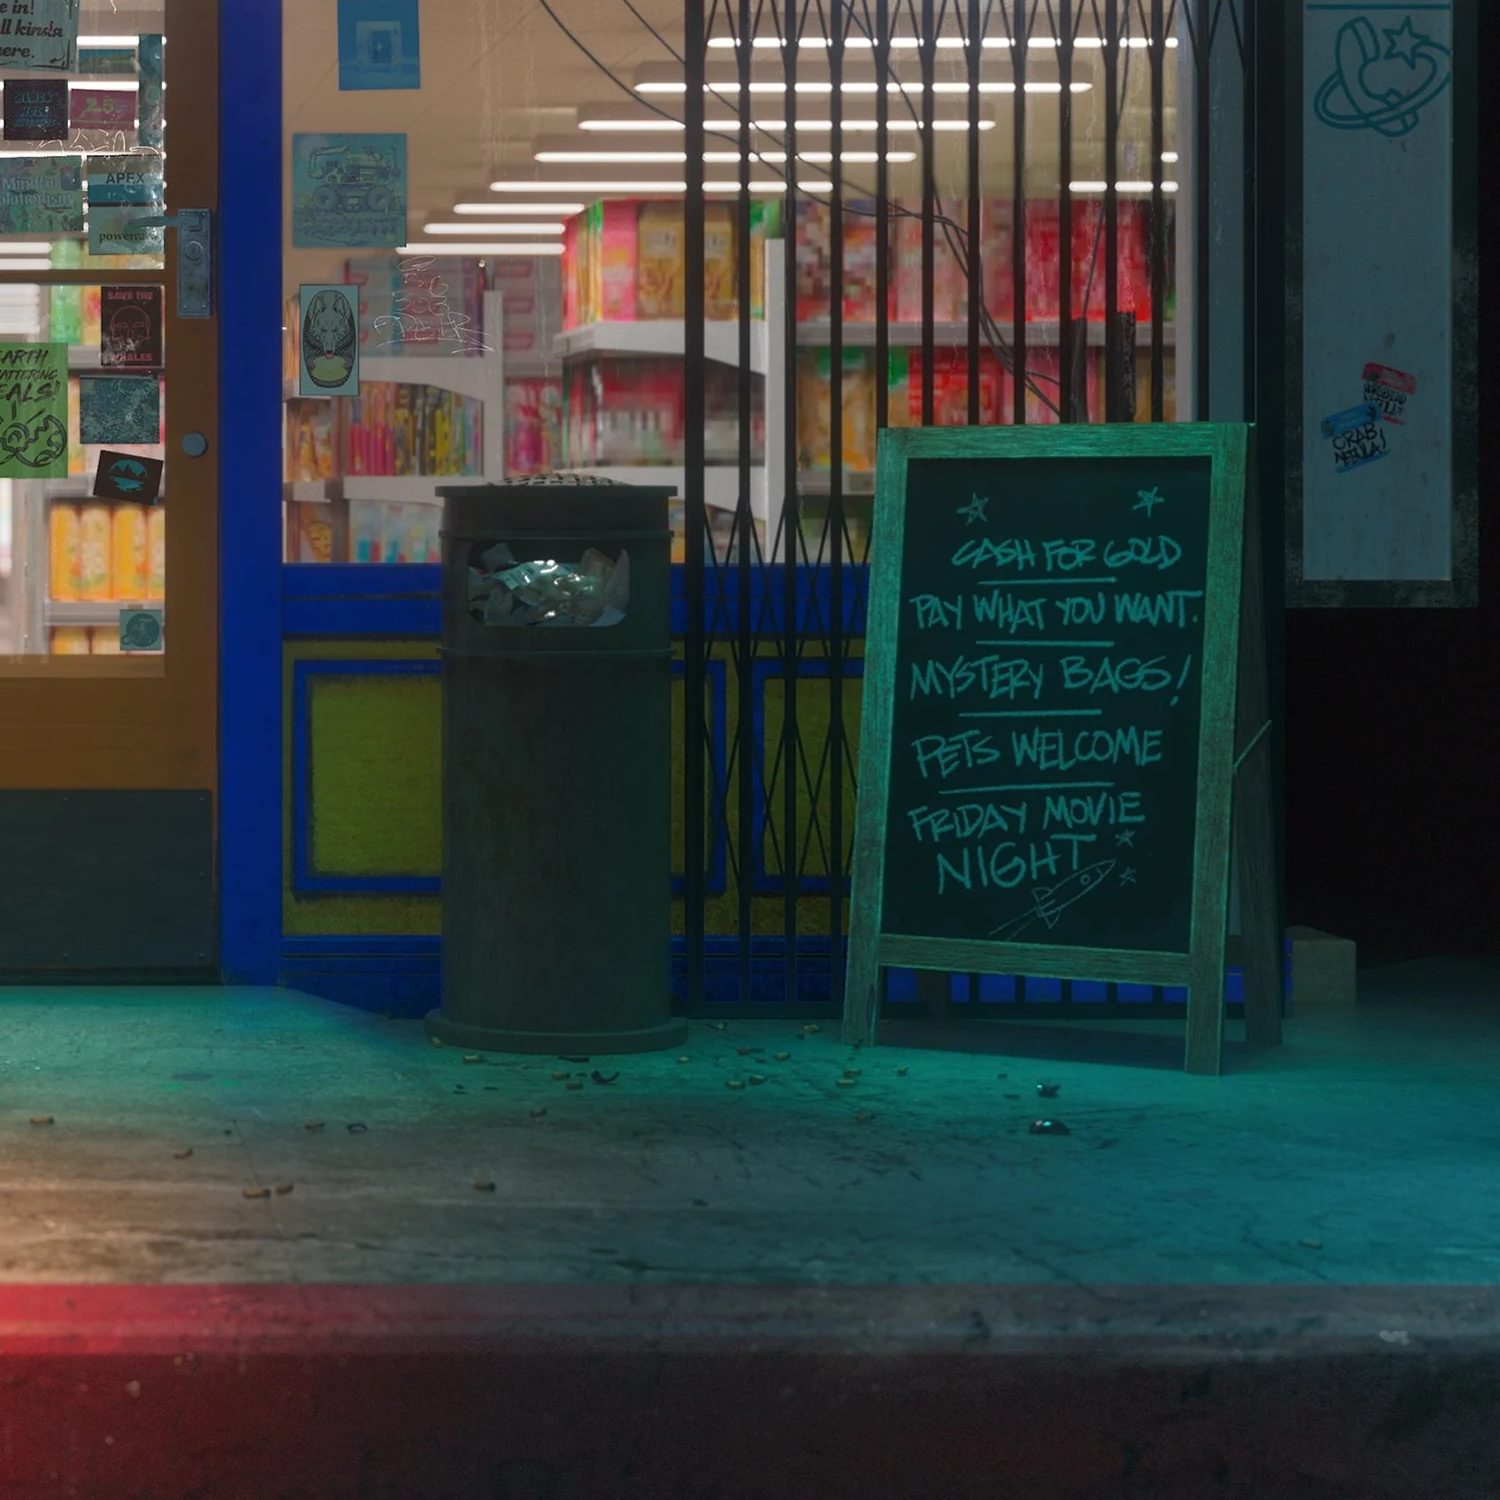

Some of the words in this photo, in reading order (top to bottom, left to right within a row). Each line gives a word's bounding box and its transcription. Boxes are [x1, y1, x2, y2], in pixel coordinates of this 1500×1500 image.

[105, 172, 146, 184] APEX
[107, 290, 133, 300] SAVE
[136, 290, 154, 300] THE
[951, 538, 1037, 571] CASH
[1042, 539, 1096, 573] FOR
[1103, 536, 1182, 571] GOLD
[909, 593, 963, 631] PAY
[973, 591, 1046, 634] WHAT
[1055, 591, 1105, 627] YOU
[1114, 589, 1204, 628] WANT.
[910, 654, 1045, 700] MYSTERY
[1059, 653, 1193, 707] BAGS!
[910, 728, 1001, 779] PETS
[1011, 725, 1164, 772] WELCOME
[907, 800, 1028, 844] FRIDAY
[1042, 791, 1147, 831] MOVIE
[936, 833, 1098, 896] NIGHT
